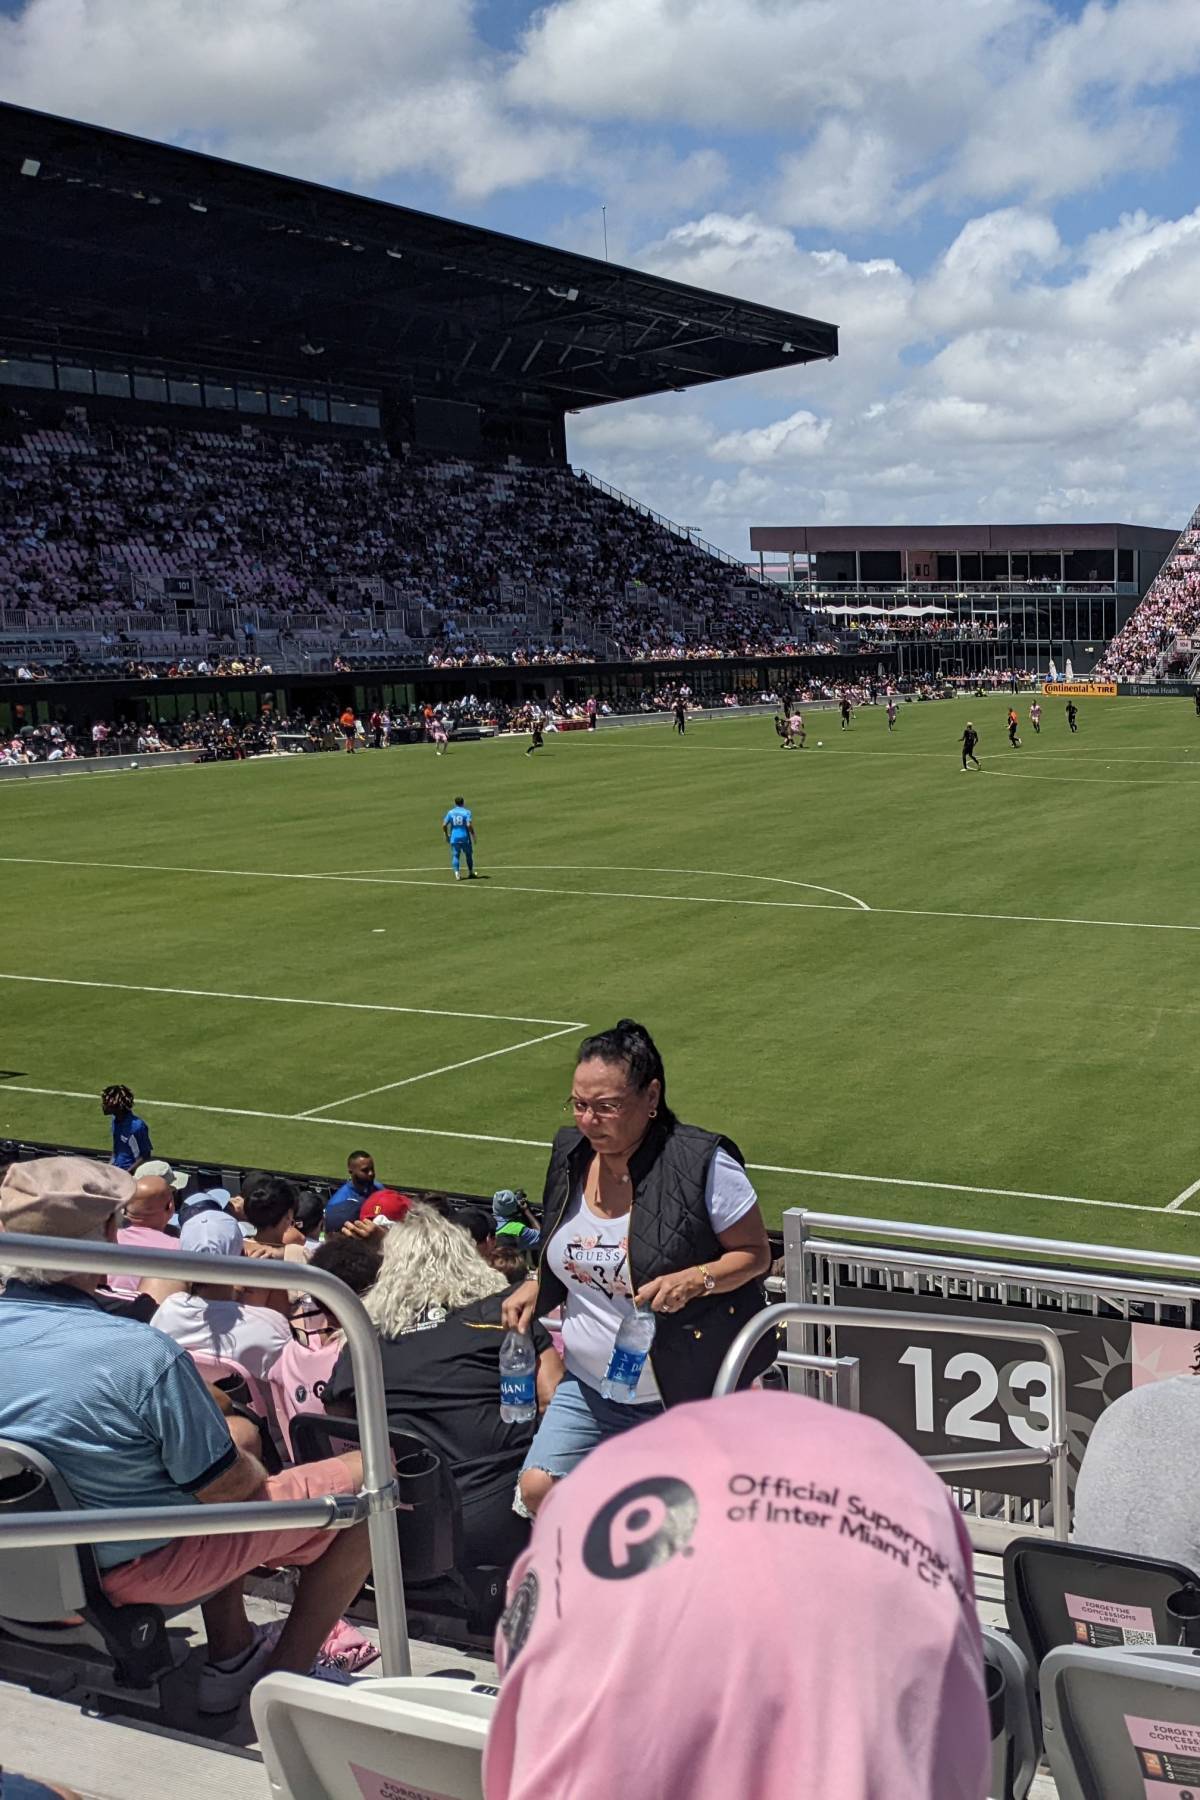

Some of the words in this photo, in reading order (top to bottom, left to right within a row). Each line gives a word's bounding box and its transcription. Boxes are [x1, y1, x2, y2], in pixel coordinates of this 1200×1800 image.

[178, 581, 190, 590] 101
[1044, 683, 1089, 693] Continental
[1096, 686, 1115, 694] TIRE
[452, 815, 464, 826] 18
[575, 1251, 620, 1261] GUESS
[898, 1346, 1051, 1450] 123
[728, 1474, 840, 1507] Official
[727, 1499, 759, 1522] of
[766, 1501, 832, 1529] Inter
[838, 1515, 910, 1568] Miami
[490, 1583, 497, 1596] 6
[1085, 1601, 1114, 1612] FORGET
[1081, 1606, 1136, 1621] CONCESSIONS
[1153, 1725, 1194, 1737] FORGET
[1165, 1763, 1172, 1771] 2
[1167, 1771, 1175, 1779] 3
